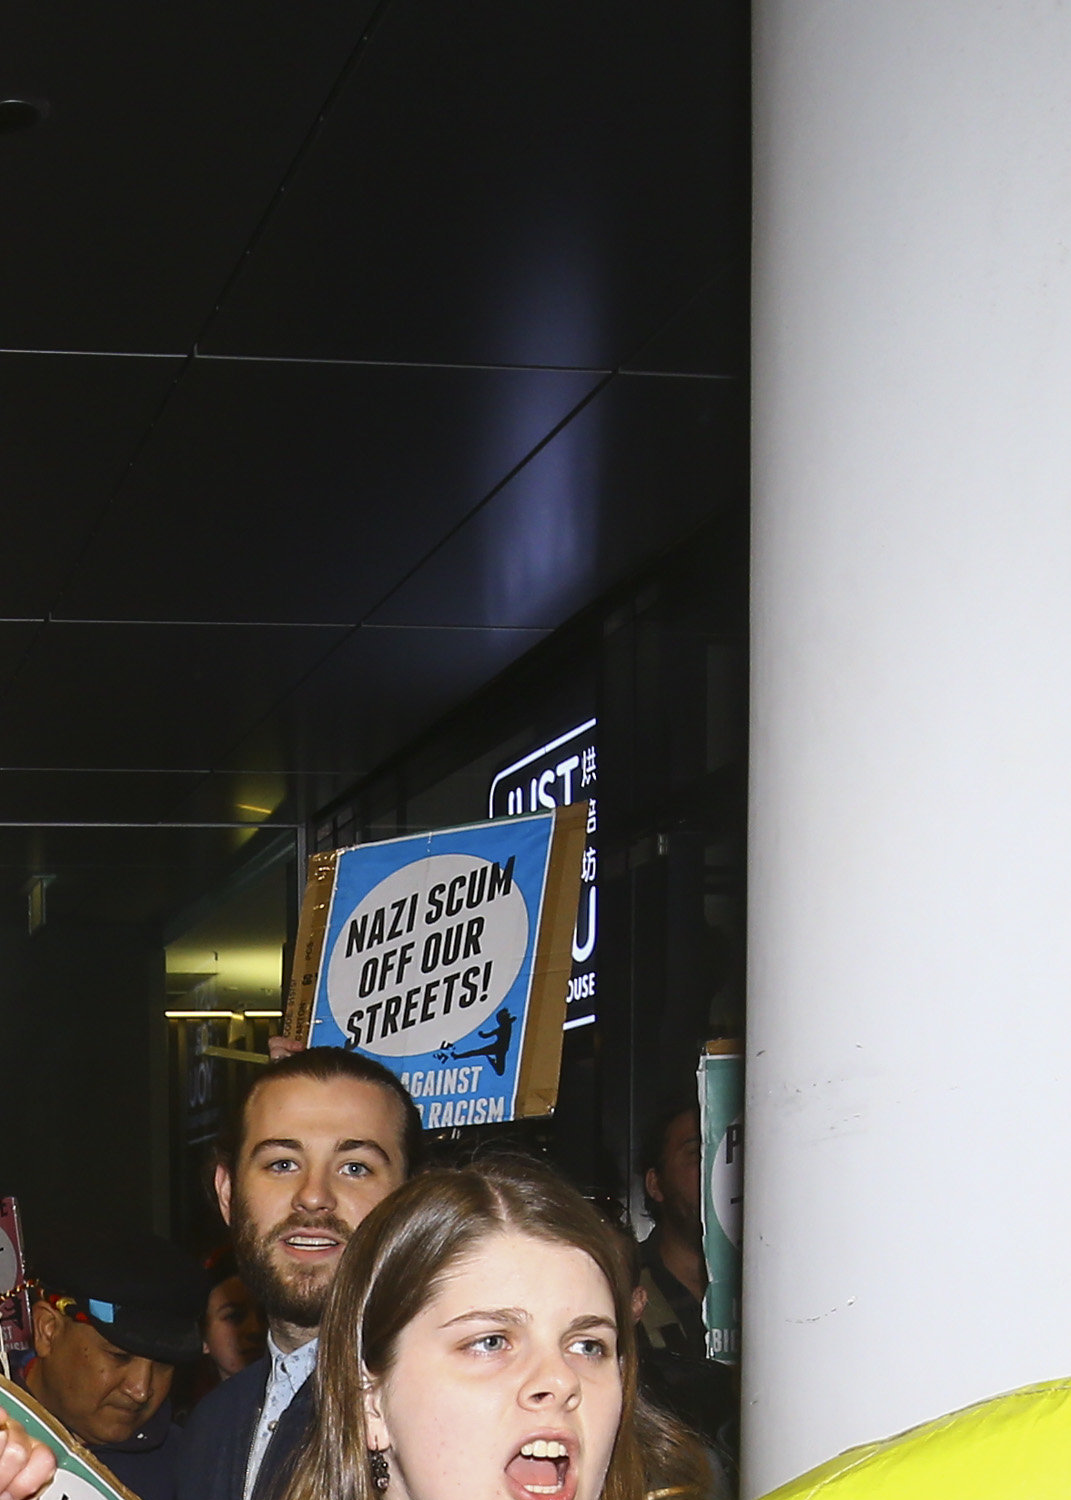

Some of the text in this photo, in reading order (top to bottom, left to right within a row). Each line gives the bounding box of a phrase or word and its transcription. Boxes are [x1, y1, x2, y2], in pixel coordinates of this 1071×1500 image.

[345, 855, 516, 958] NAZI SCUM
[358, 942, 415, 998] OFF
[421, 917, 484, 974] OUR
[344, 961, 493, 1050] STREETS!
[400, 1066, 483, 1098] AGAINST
[429, 1097, 504, 1129] RACISM
